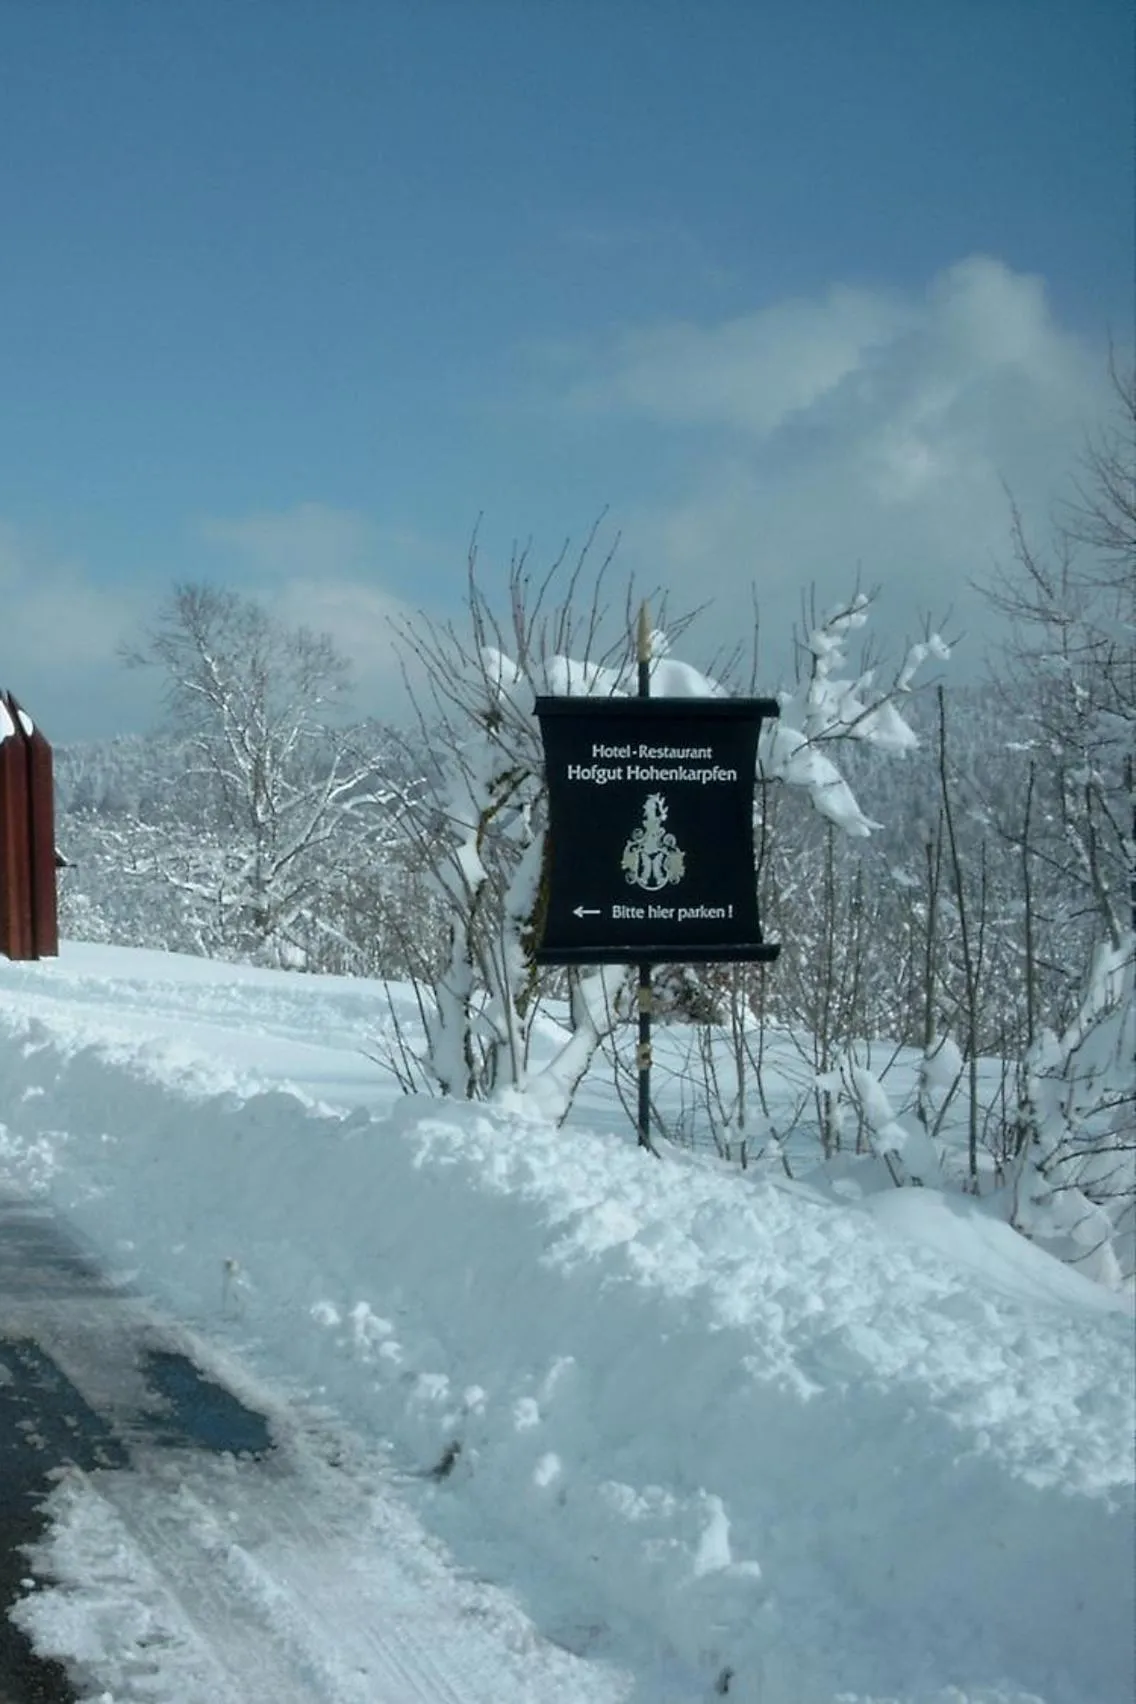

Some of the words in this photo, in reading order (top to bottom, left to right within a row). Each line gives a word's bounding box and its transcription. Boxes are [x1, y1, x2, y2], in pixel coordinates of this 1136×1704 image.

[567, 765, 623, 784] Hofgut
[627, 766, 737, 784] Hohenkarpfen
[612, 905, 644, 919] Bitte
[648, 905, 674, 919] hier
